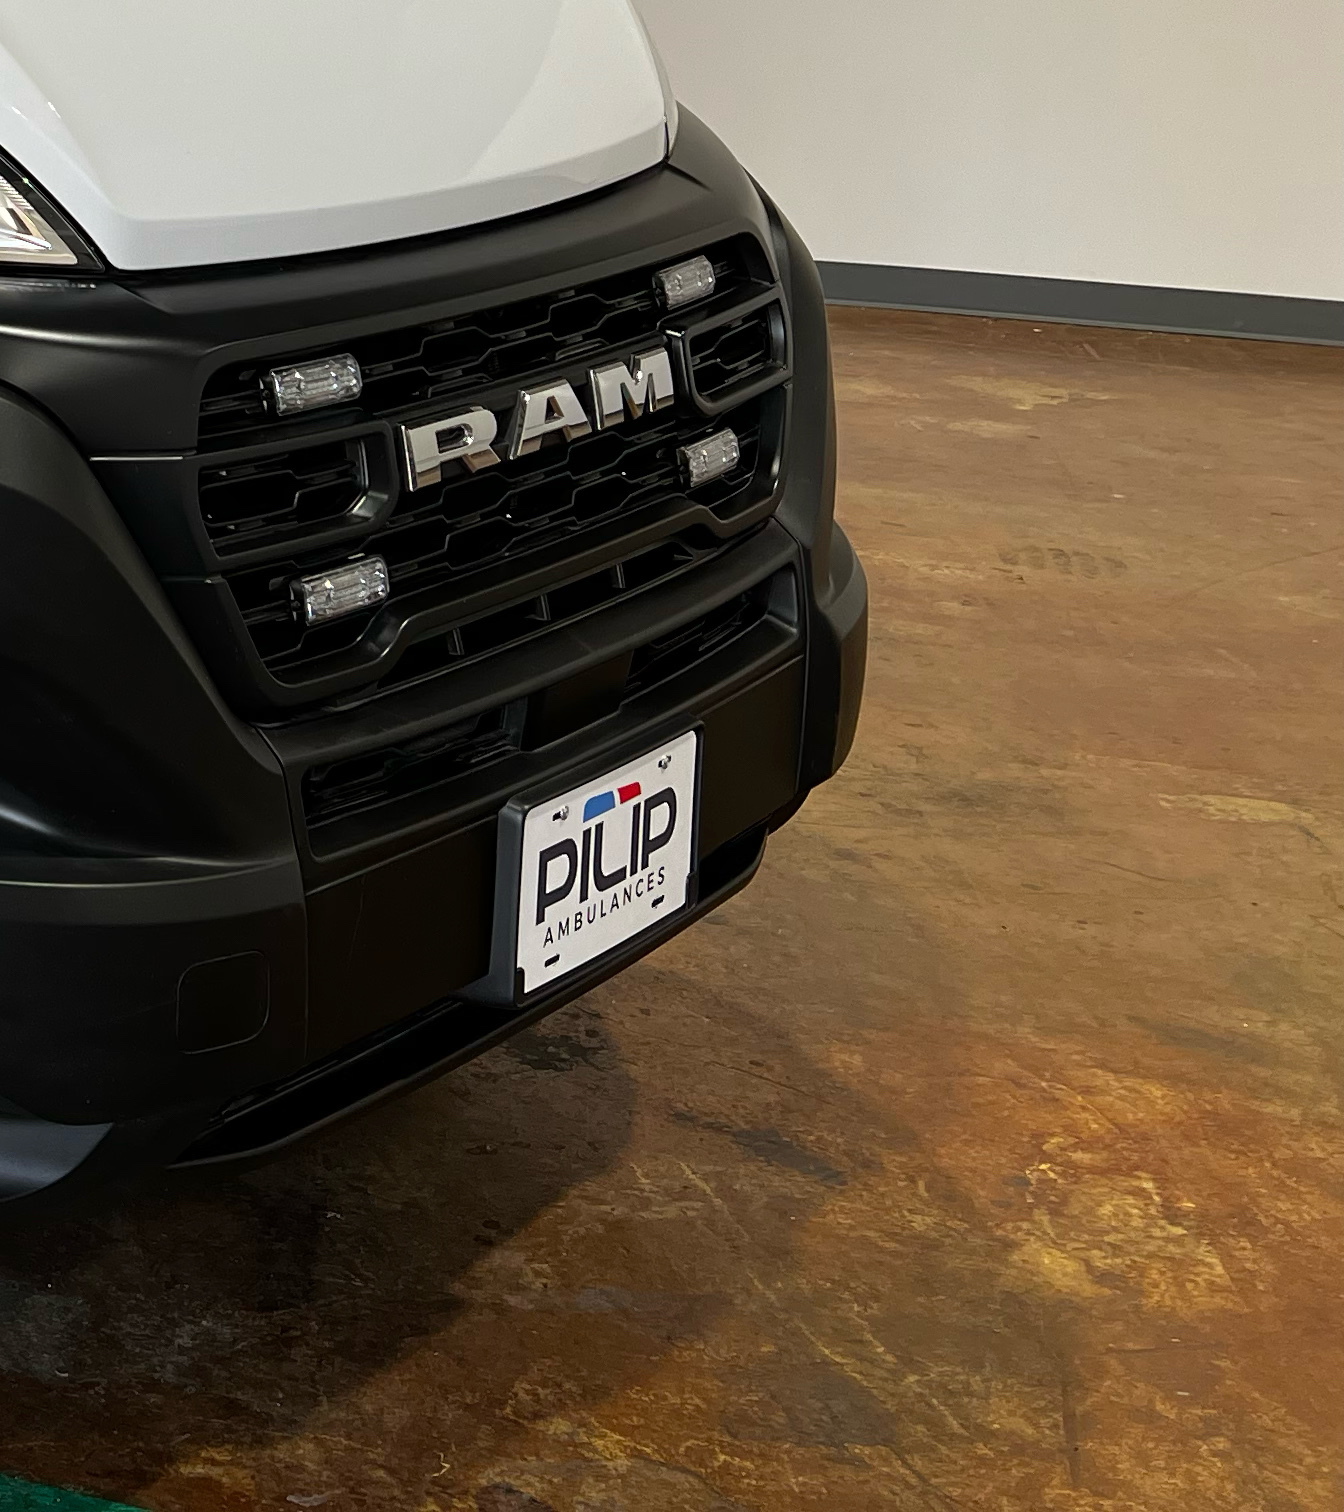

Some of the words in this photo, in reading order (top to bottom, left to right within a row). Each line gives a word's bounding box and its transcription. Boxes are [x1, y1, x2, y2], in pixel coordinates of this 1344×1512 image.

[400, 345, 674, 491] RAM
[535, 786, 677, 926] PILIP
[543, 866, 665, 948] AMBULANCES
